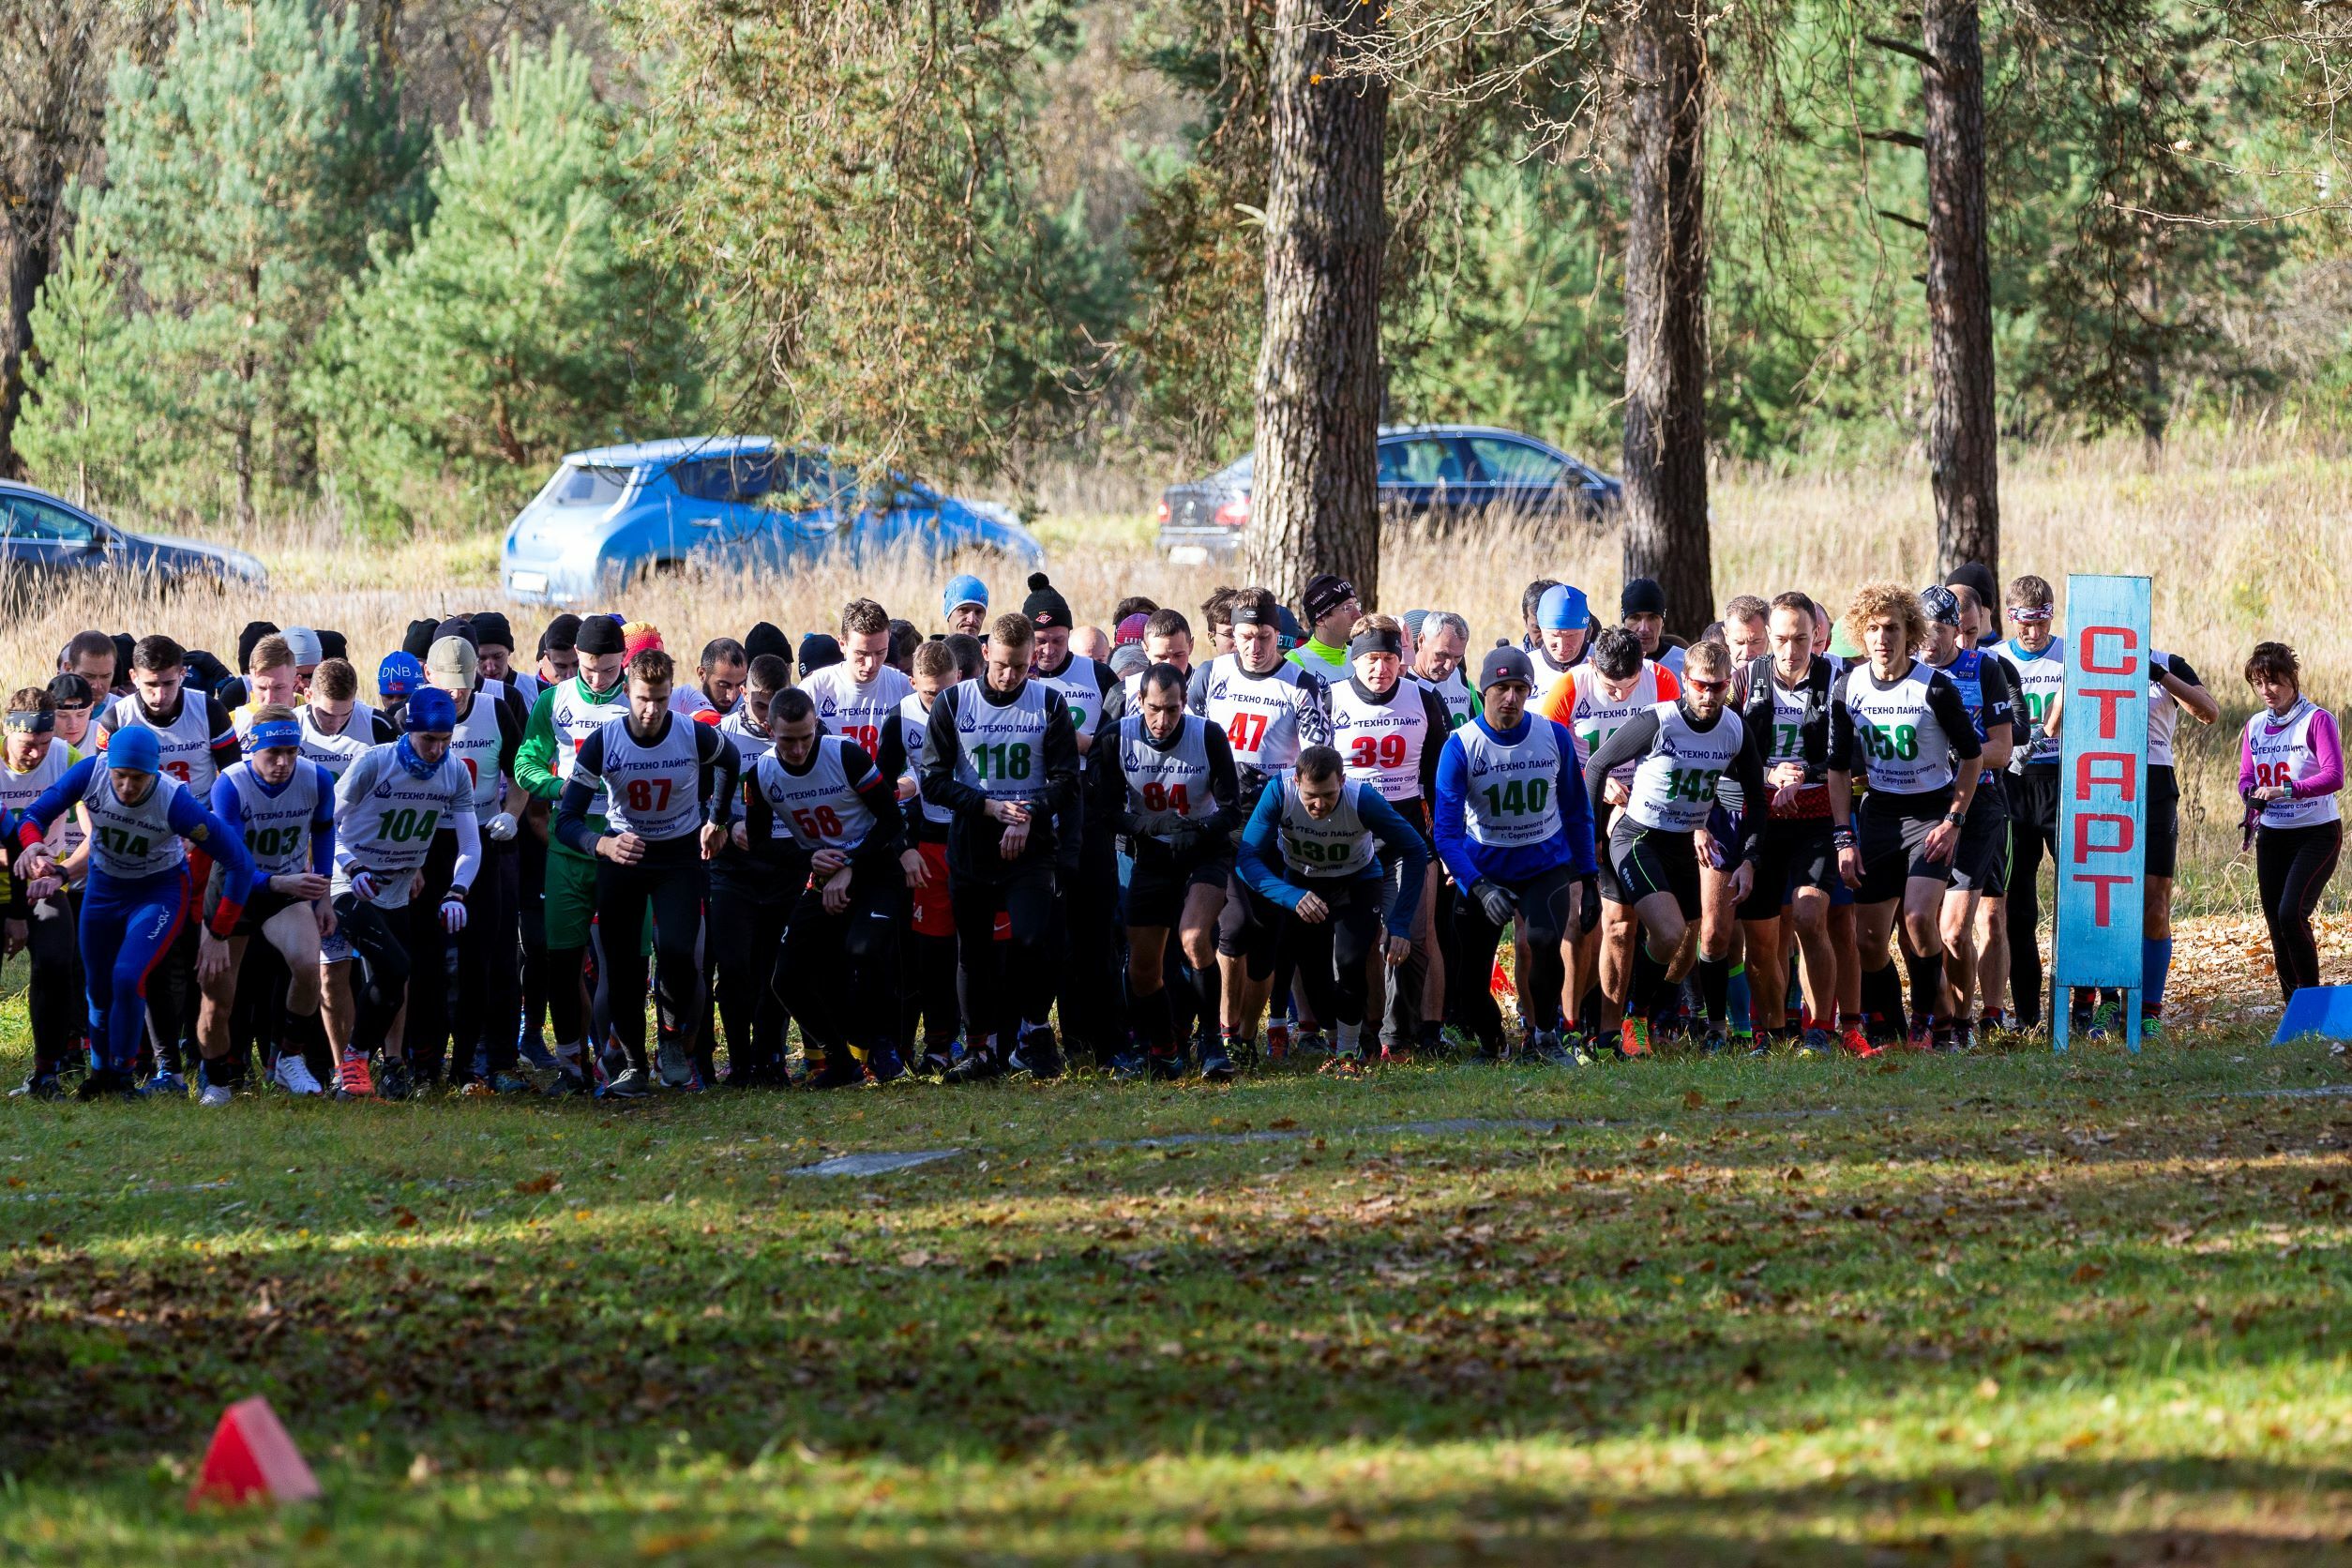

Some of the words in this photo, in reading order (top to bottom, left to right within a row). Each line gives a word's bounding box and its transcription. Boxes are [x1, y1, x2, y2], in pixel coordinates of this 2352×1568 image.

[382, 663, 411, 683] DNB
[2044, 674, 2062, 684] ЛАЙ
[575, 719, 607, 729] "ТЕХН
[872, 707, 890, 716] ЛАЙ
[977, 724, 1014, 733] "ТЕХНО
[1353, 718, 1391, 728] "ТЕХНО
[1630, 707, 1642, 716] ЛА
[841, 725, 879, 762] 78
[1228, 712, 1268, 752] 47
[1859, 723, 1919, 762] 158
[343, 753, 354, 762] ЛА
[624, 761, 659, 771] "ТЕХНО
[971, 742, 1031, 781] 118
[1351, 734, 1406, 769] 39
[1664, 767, 1724, 802] 143
[2073, 626, 2137, 927] СТАРТ
[2256, 761, 2291, 788] 86
[626, 778, 672, 812] 87
[1143, 781, 1191, 816] 84
[1482, 777, 1548, 818] 140
[376, 807, 439, 842] 104
[792, 805, 842, 839] 58
[246, 825, 302, 856] 103
